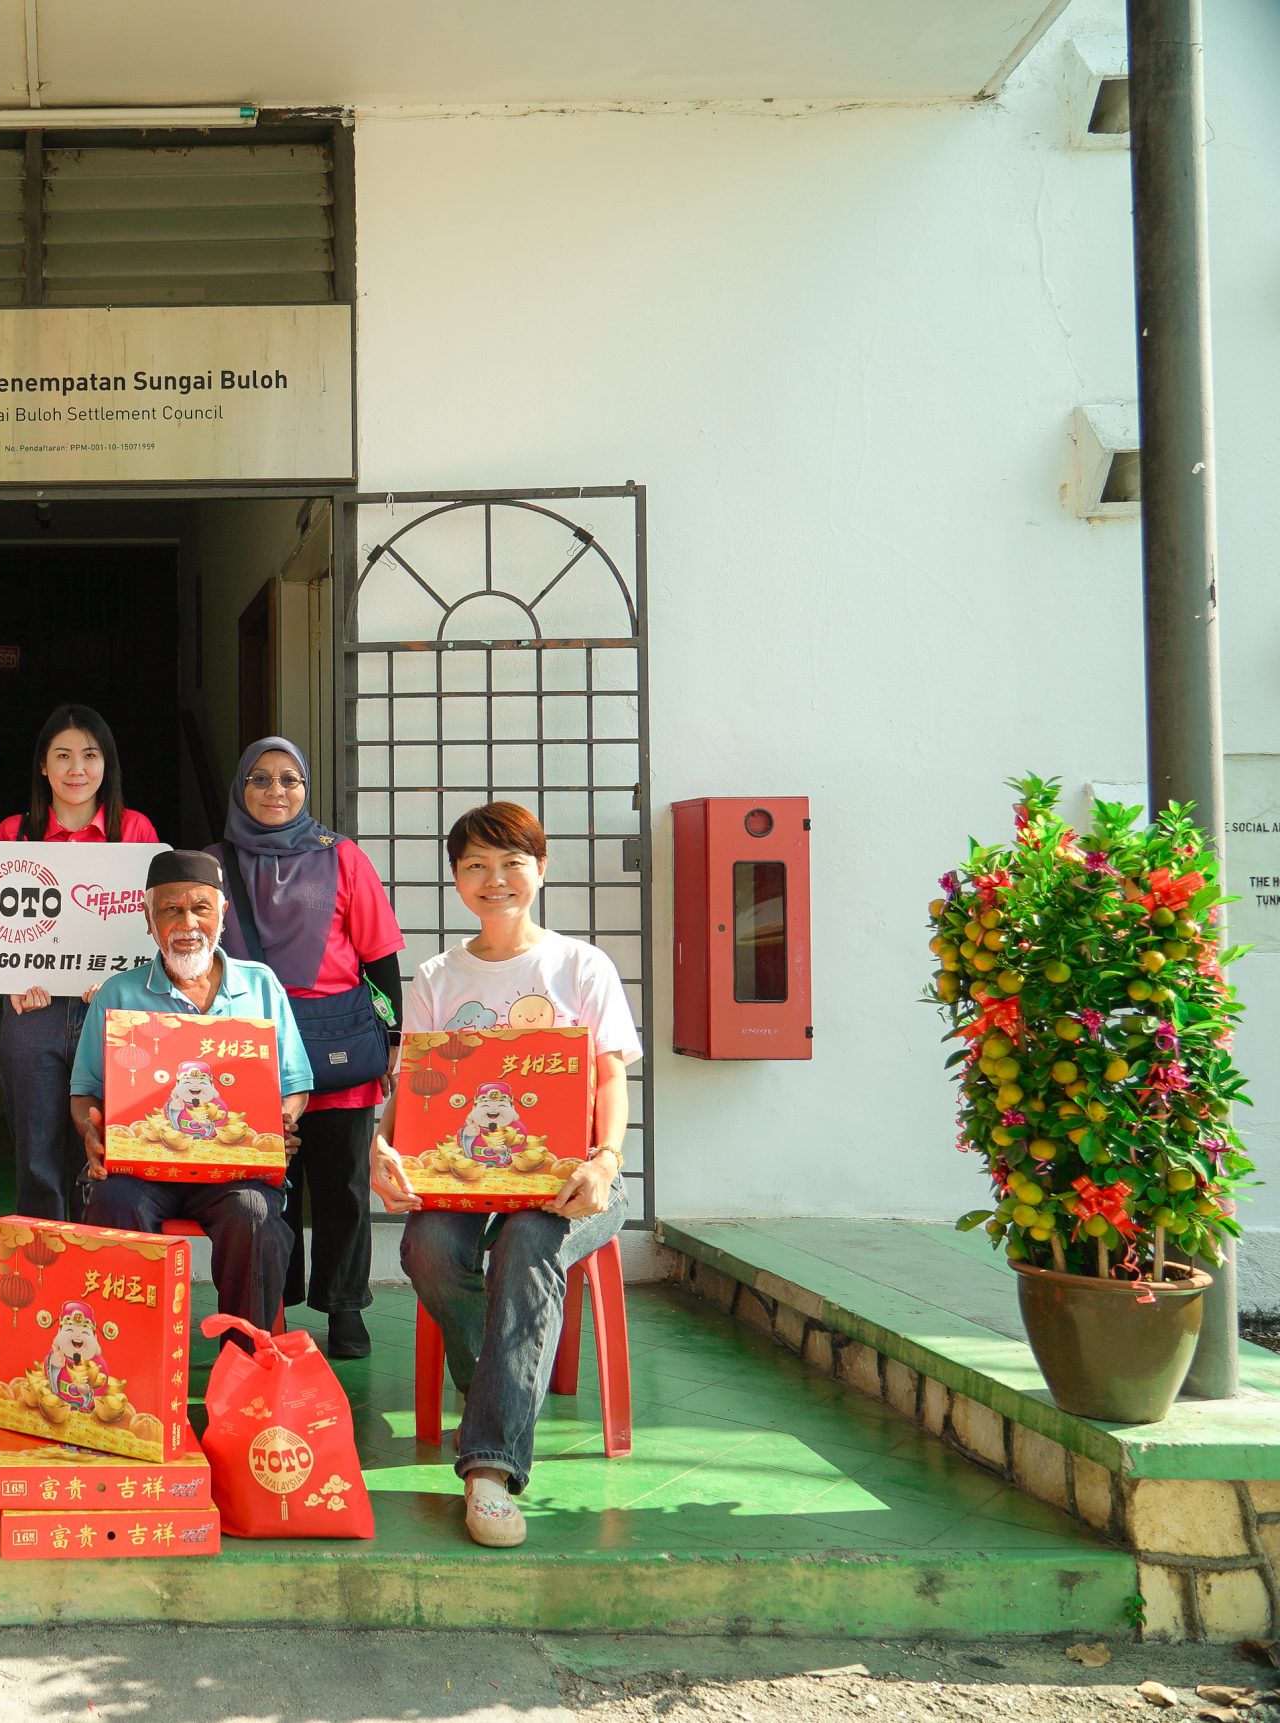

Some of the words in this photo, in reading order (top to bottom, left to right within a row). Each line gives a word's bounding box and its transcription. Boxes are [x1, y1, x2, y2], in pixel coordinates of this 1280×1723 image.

[133, 371, 212, 395] Sungai
[221, 370, 288, 390] Buloh
[15, 407, 62, 422] Buloh
[67, 406, 157, 421] Settlement
[162, 405, 224, 420] Council
[20, 444, 68, 452] Pendaftaran:
[70, 443, 155, 451] PPM-001-10-15071959
[1232, 822, 1270, 832] SOCIAL
[0, 859, 41, 877] SPORTS
[1249, 876, 1270, 887] THE
[98, 903, 145, 921] HANDS
[24, 953, 56, 970] FOR
[60, 953, 81, 970] IT!
[208, 1168, 247, 1180] 吉祥
[252, 1446, 312, 1473] TOTO
[39, 1475, 87, 1500] 富贵
[117, 1475, 165, 1501] 吉祥
[262, 1476, 303, 1491] MALAYSIA
[50, 1523, 98, 1549] 富贵
[127, 1522, 176, 1547] 吉祥
